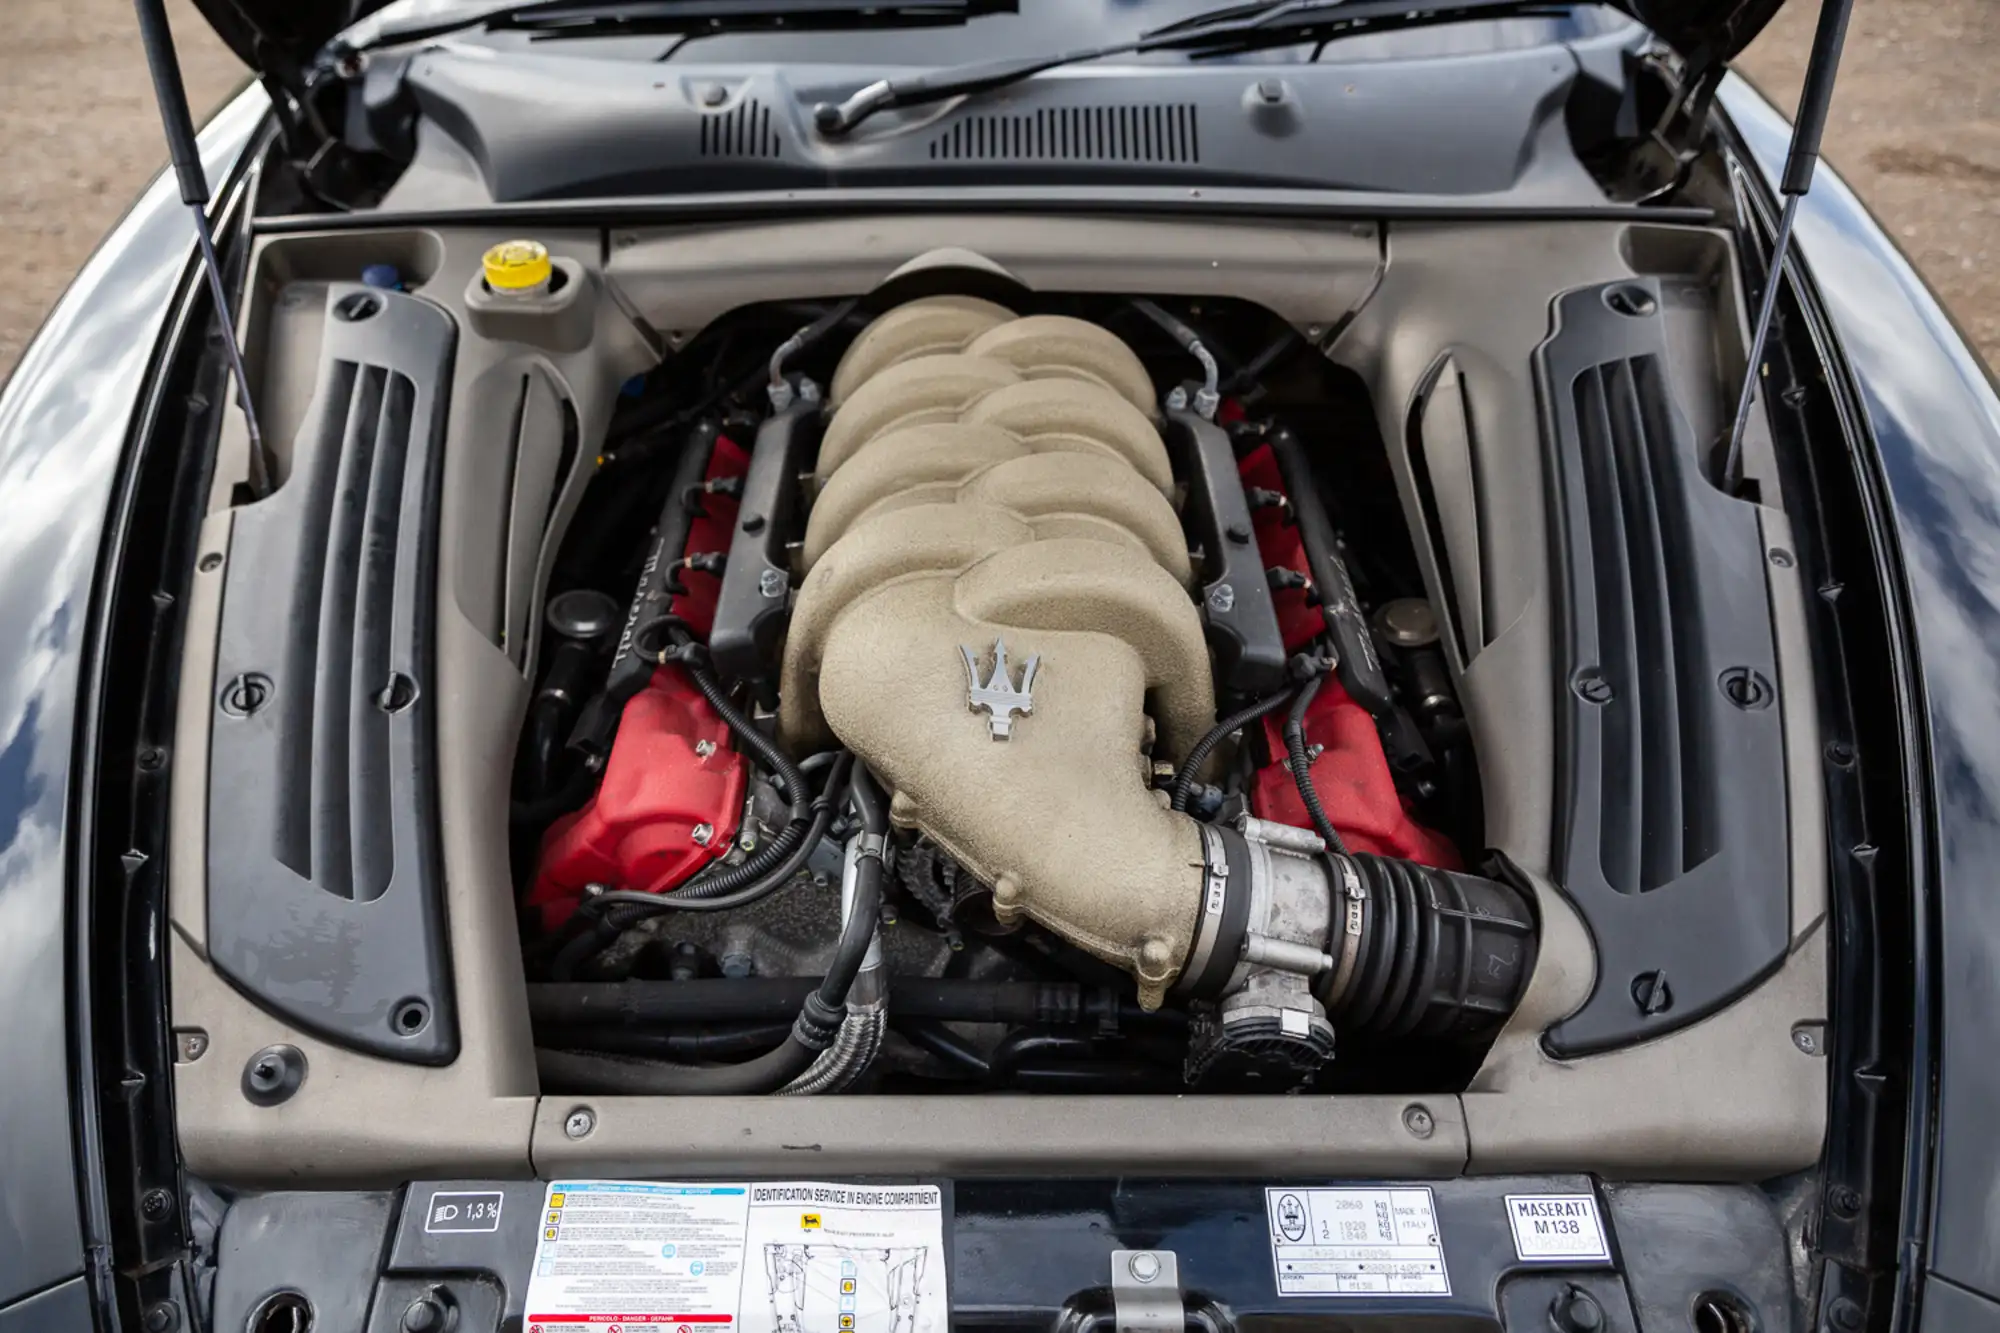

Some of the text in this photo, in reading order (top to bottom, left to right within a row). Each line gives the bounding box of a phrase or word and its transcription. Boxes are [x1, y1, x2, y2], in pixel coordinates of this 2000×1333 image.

[753, 1188, 938, 1205] IDENTIFICATION SERVICE IN ENGINE COMPARTMENT
[466, 1202, 498, 1221] 1,3 %
[1374, 1200, 1387, 1211] kg
[1394, 1207, 1431, 1216] MADE IN
[1518, 1202, 1588, 1217] MASERATI
[1376, 1209, 1389, 1221] kg
[1378, 1219, 1391, 1231] kg
[1402, 1221, 1427, 1229] ITALY
[1534, 1220, 1580, 1234] M138
[1322, 1229, 1330, 1239] 2
[1380, 1229, 1392, 1241] kg
